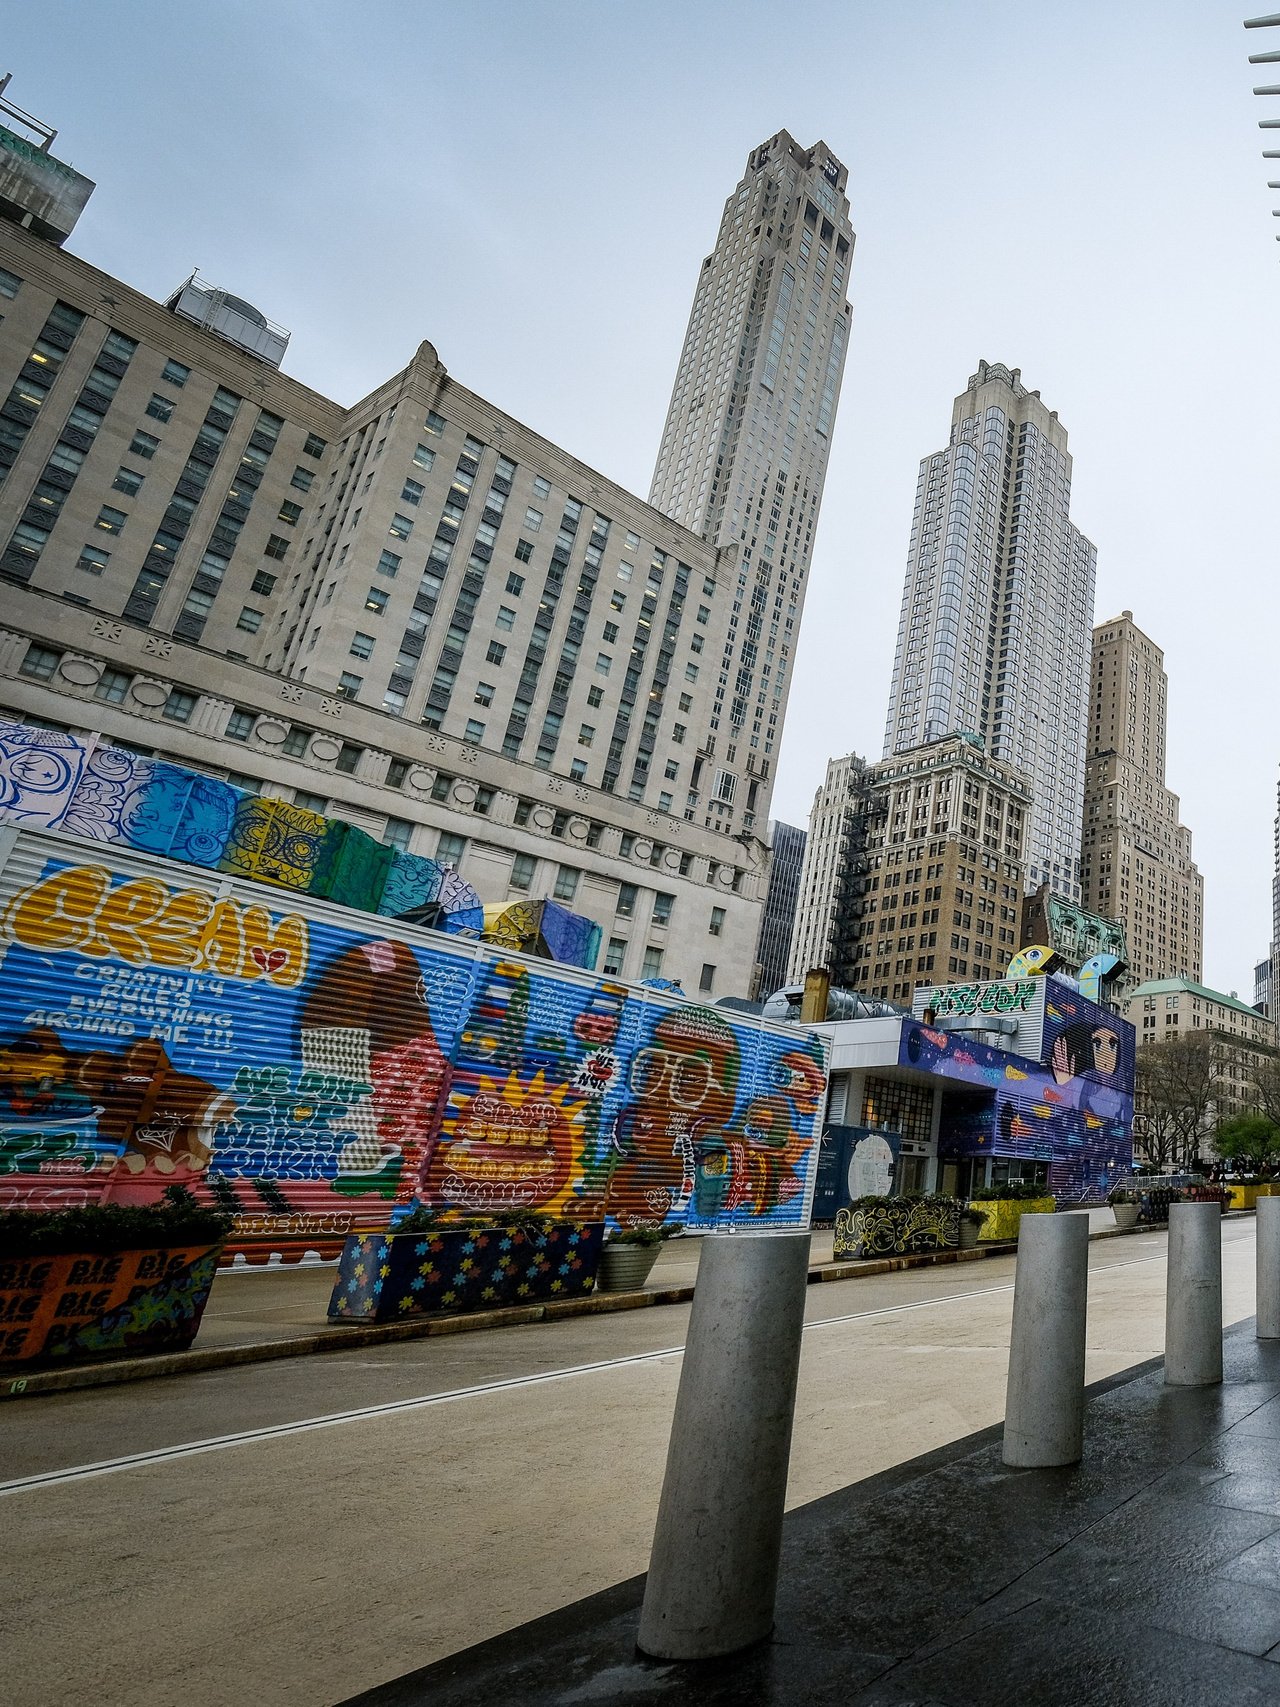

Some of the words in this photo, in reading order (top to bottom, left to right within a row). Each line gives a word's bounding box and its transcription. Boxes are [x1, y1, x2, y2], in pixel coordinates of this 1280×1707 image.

[74, 963, 225, 997] CREATIVITY
[101, 984, 192, 1008] RULES
[67, 995, 233, 1027] EVERYTHING
[23, 1009, 136, 1036] AROUND
[150, 1024, 189, 1043] ME
[596, 1054, 615, 1069] WE
[234, 1065, 291, 1095] WE
[578, 1073, 606, 1091] NYC
[67, 1257, 124, 1279] BIG
[136, 1251, 187, 1273] BIG
[56, 1289, 112, 1310] BIG
